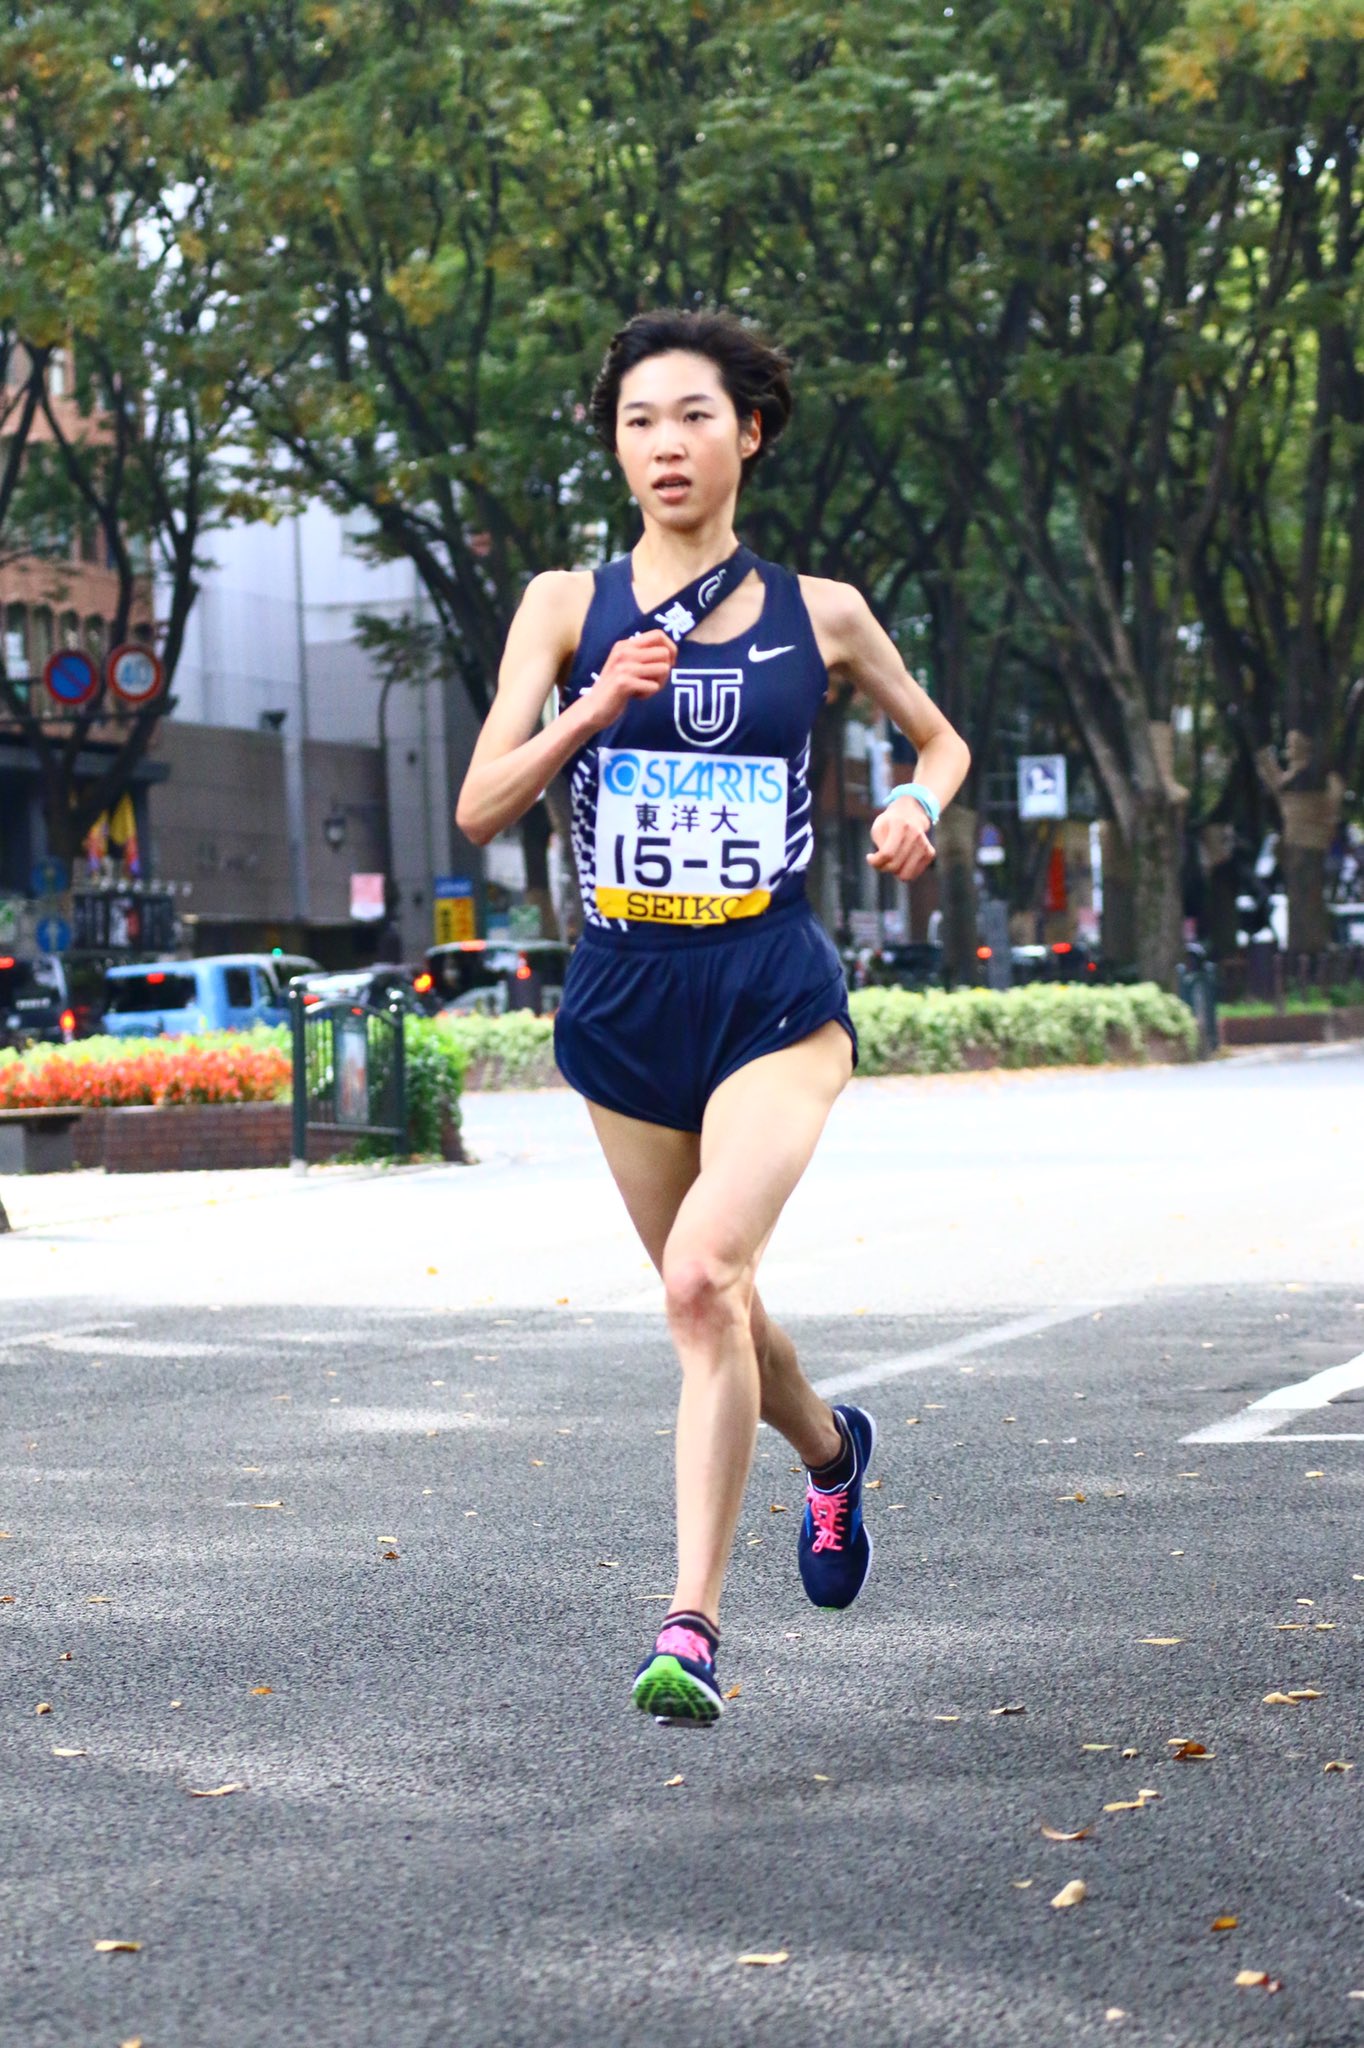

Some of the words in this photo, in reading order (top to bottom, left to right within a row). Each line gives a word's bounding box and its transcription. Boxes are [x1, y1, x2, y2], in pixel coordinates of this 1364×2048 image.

[635, 803, 739, 834] 東洋大
[614, 834, 761, 890] 15-5
